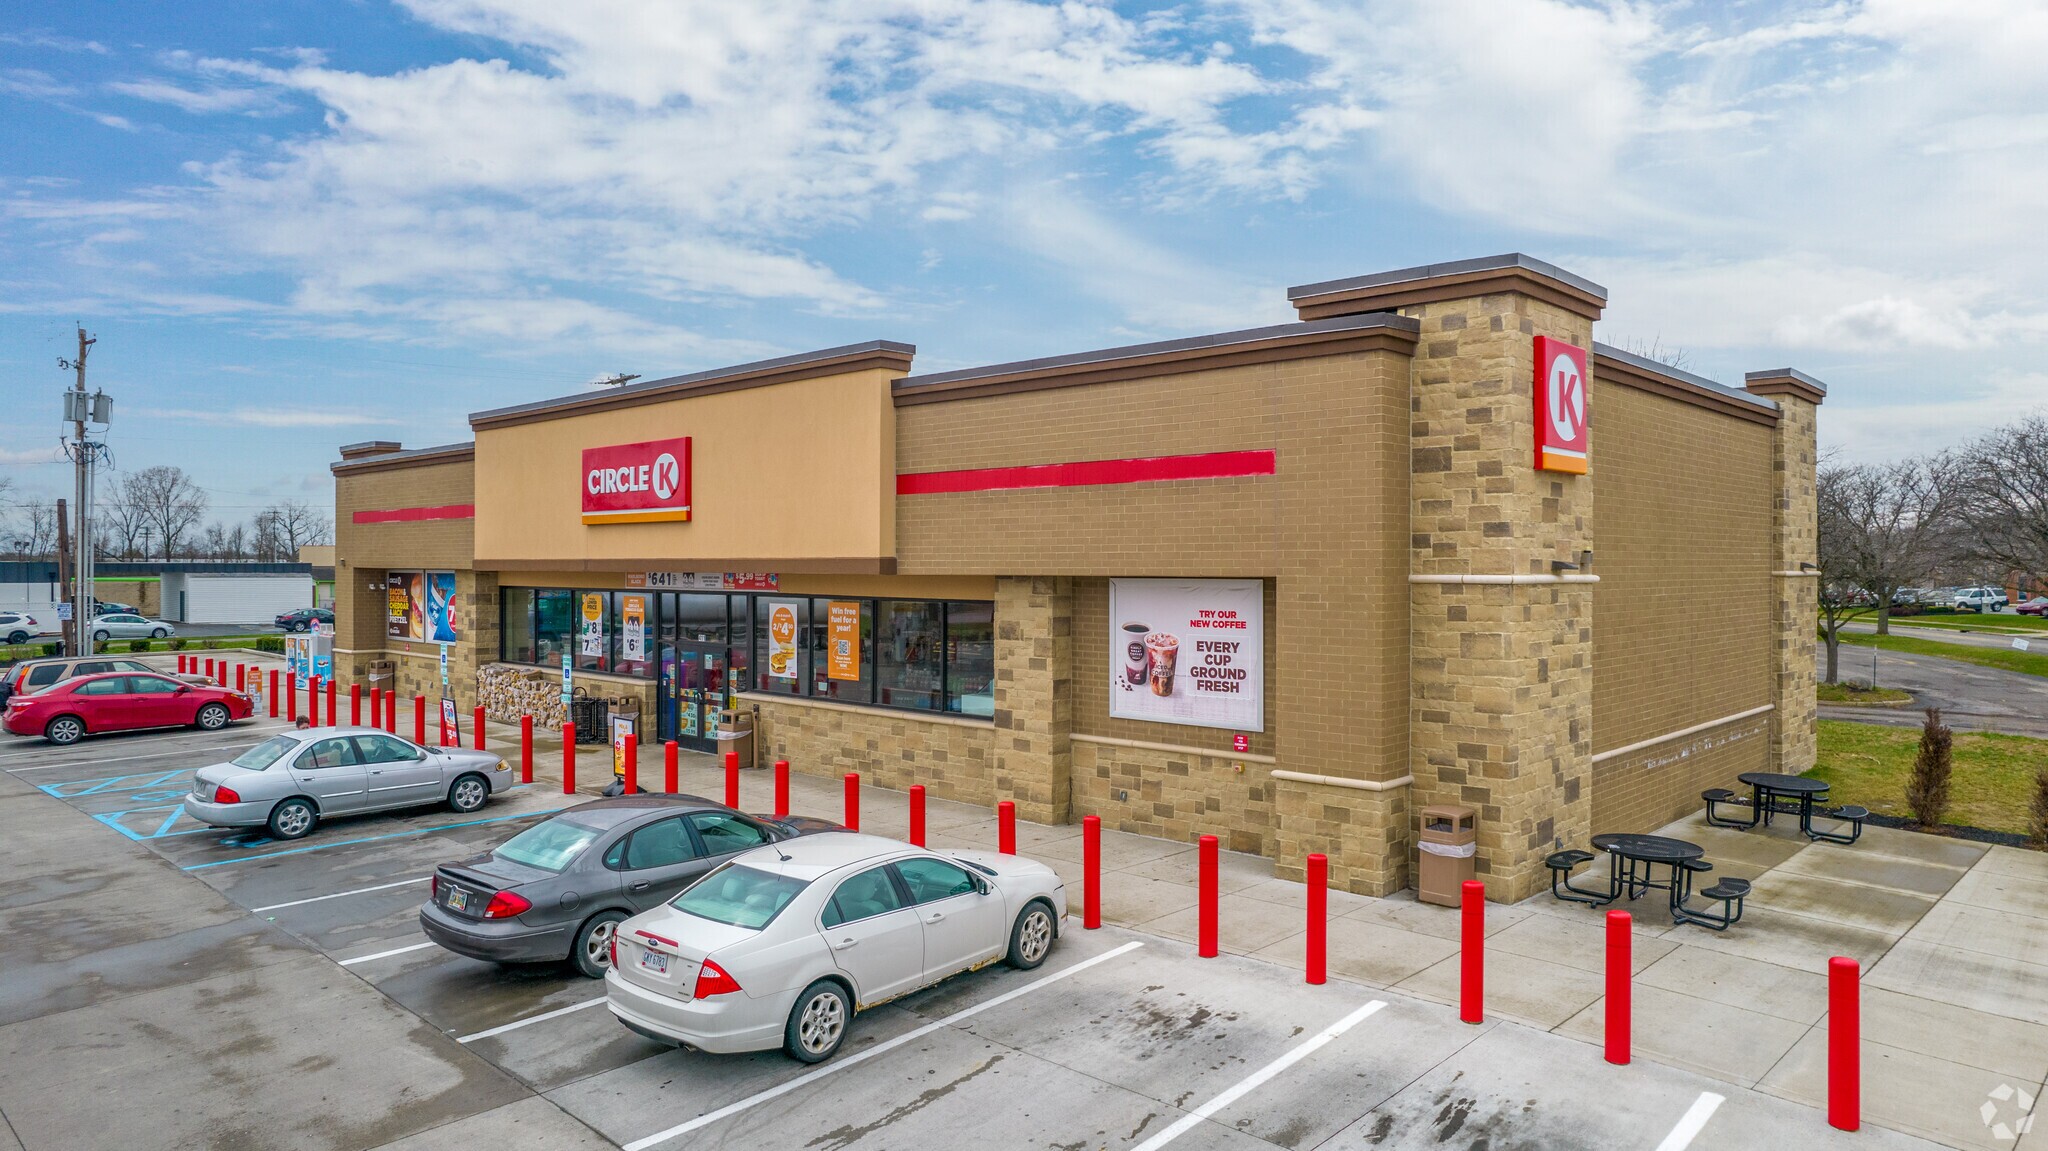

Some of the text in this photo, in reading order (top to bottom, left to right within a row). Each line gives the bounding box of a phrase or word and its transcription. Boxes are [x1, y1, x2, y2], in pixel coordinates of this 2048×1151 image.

[1556, 365, 1580, 437] K
[588, 459, 678, 497] CIRCLE K
[1212, 621, 1246, 629] COFFEE
[1196, 641, 1240, 653] EVERY
[1205, 654, 1231, 666] CUP
[1190, 666, 1246, 680] GROUND
[1197, 680, 1239, 693] FRESH
